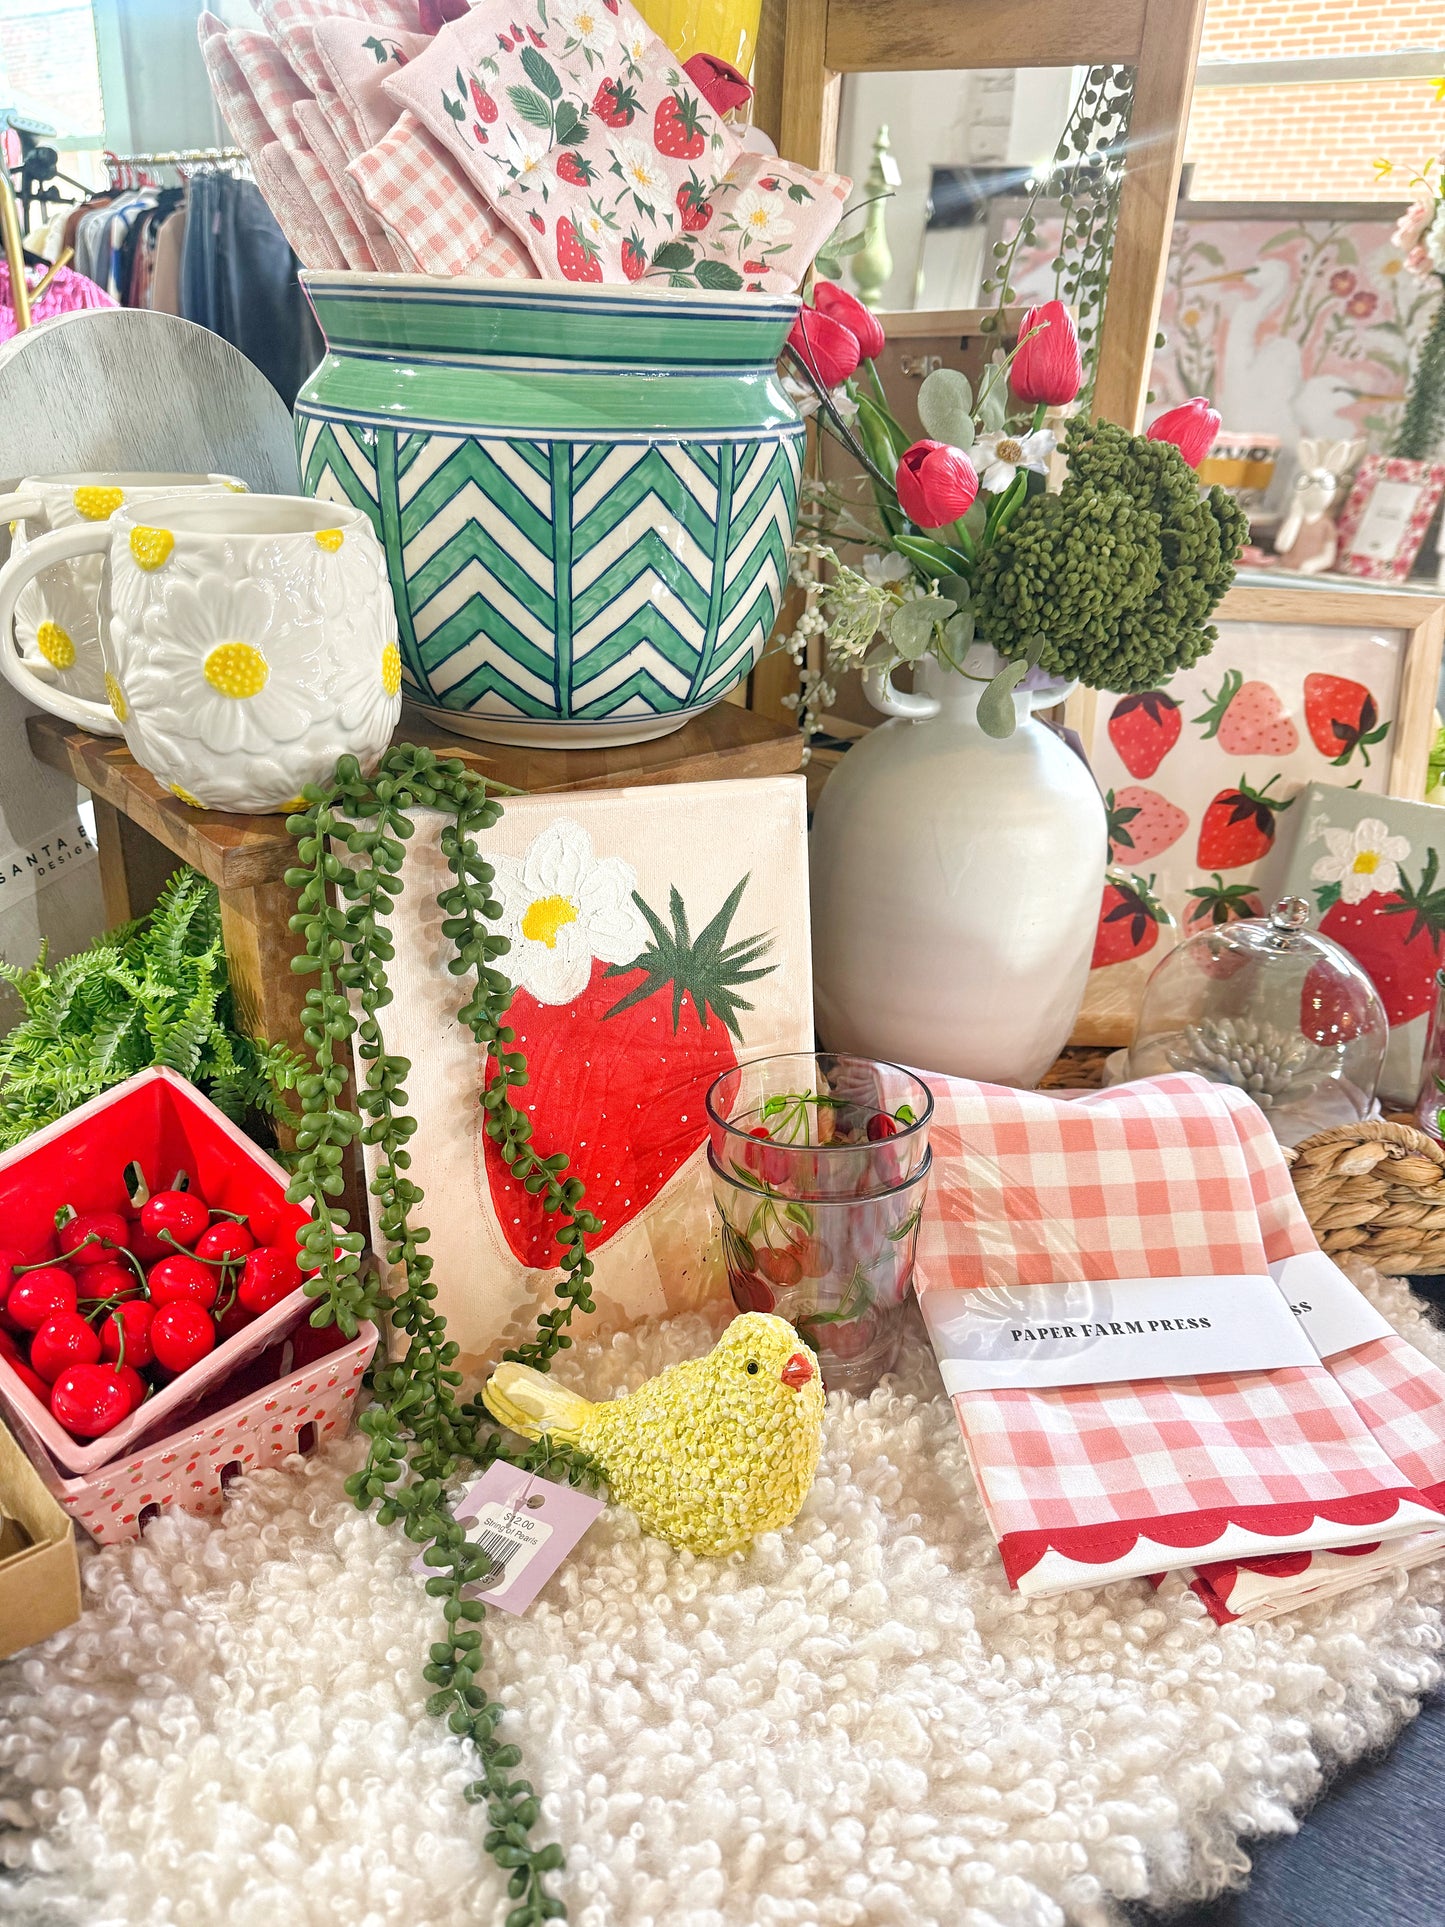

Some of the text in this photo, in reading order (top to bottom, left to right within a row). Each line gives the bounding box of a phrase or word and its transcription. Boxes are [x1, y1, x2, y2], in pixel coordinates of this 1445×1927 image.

[1010, 1317, 1212, 1342] PAPER FARM PRESS
[483, 1517, 505, 1533] String
[514, 1530, 539, 1546] Pearls
